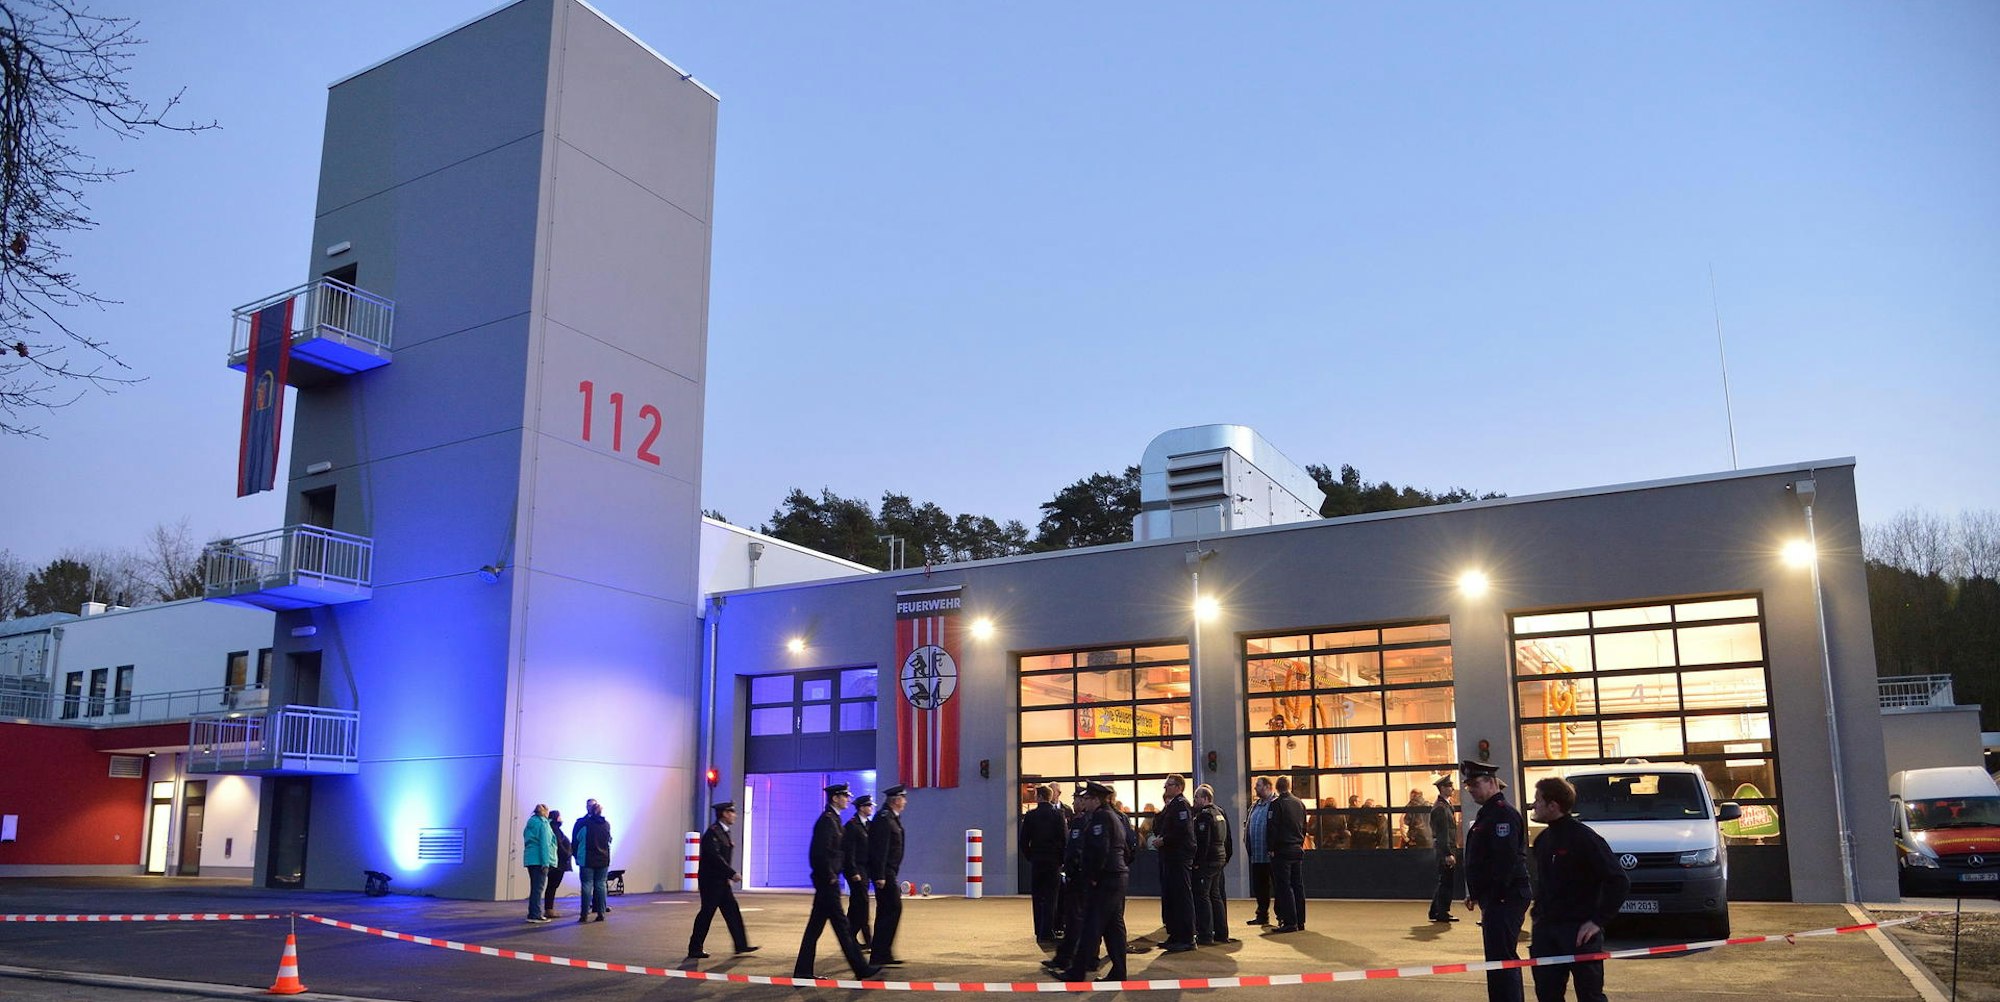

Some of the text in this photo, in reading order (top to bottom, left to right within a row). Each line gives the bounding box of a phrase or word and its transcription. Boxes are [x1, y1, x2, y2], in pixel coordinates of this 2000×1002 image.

[579, 380, 662, 466] 112
[896, 597, 961, 613] FEUERWEHR
[1631, 683, 1646, 702] 4
[1343, 701, 1355, 720] 3
